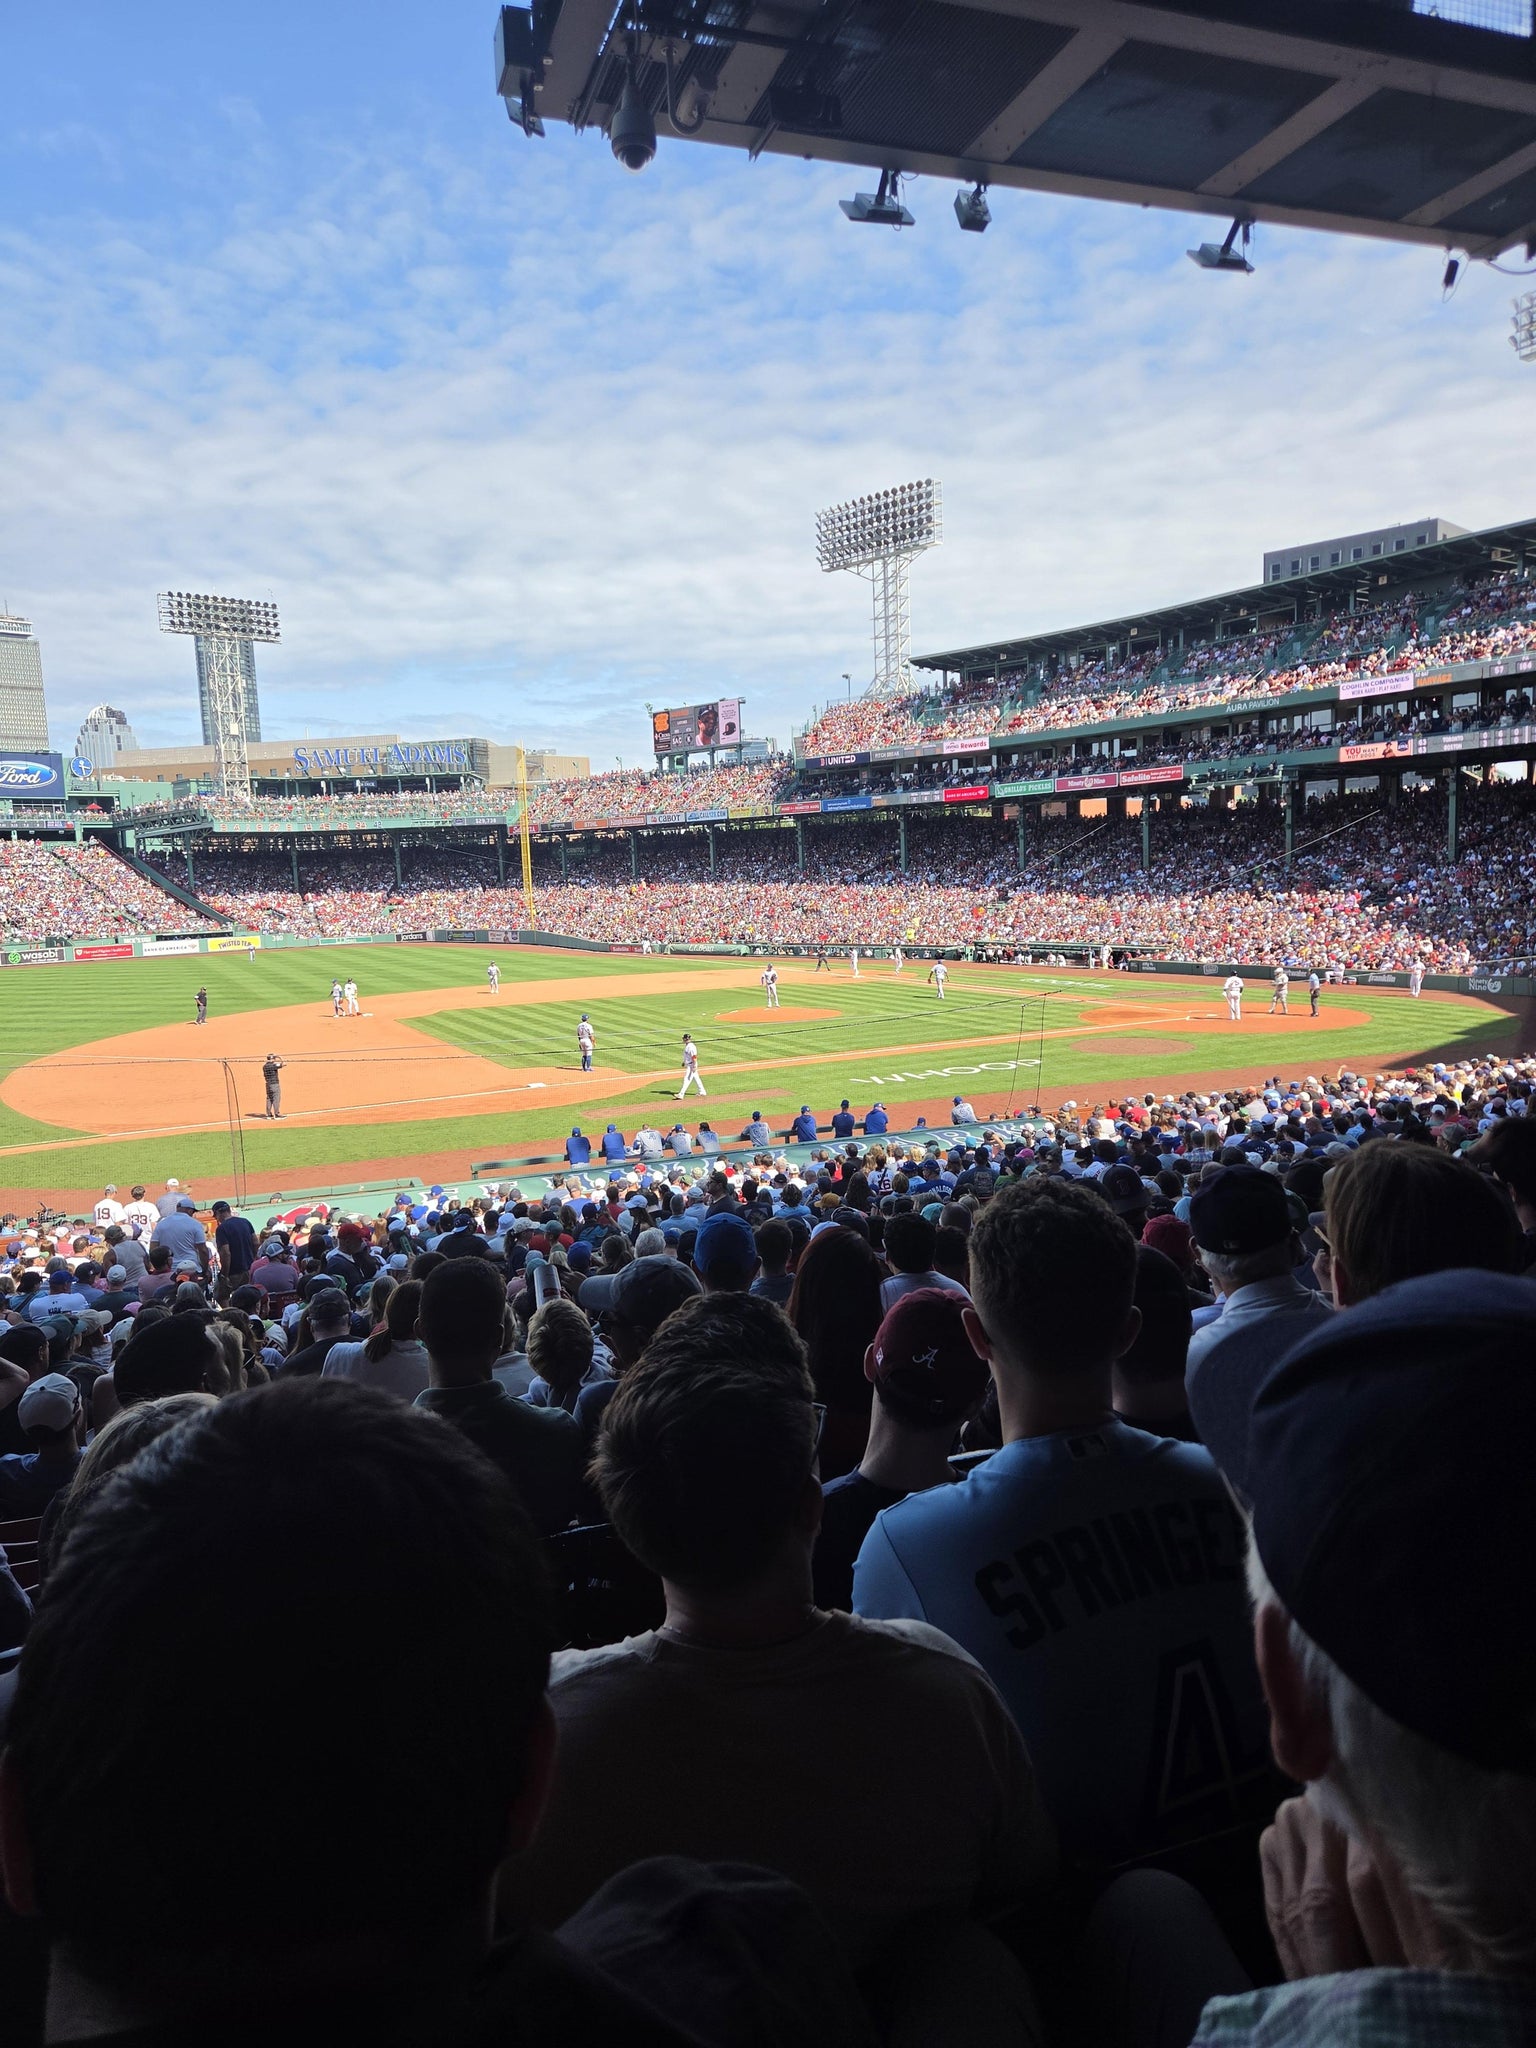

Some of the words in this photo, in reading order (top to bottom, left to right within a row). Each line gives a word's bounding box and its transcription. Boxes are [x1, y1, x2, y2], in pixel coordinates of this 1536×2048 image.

[1341, 682, 1369, 691] COGHLIN
[1370, 676, 1410, 687] COMPANIES
[1248, 698, 1280, 709] PAVILION
[1442, 735, 1464, 743] TORONTO
[960, 741, 987, 749] Rewards
[1443, 743, 1463, 751] BOSTON
[1345, 747, 1361, 755] YOU
[293, 745, 384, 772] SAMUEL
[389, 743, 468, 765] ADAMS
[828, 755, 856, 766] UNITED
[0, 765, 41, 784] Ford
[1122, 774, 1151, 783] Safelite
[218, 940, 241, 950] TWISTED
[22, 949, 58, 961] wasabi
[1368, 972, 1396, 983] Franklin
[849, 1058, 1043, 1086] WHOOP
[97, 1207, 111, 1220] 19
[131, 1214, 148, 1225] 33
[975, 1497, 1242, 1651] SPRINGE
